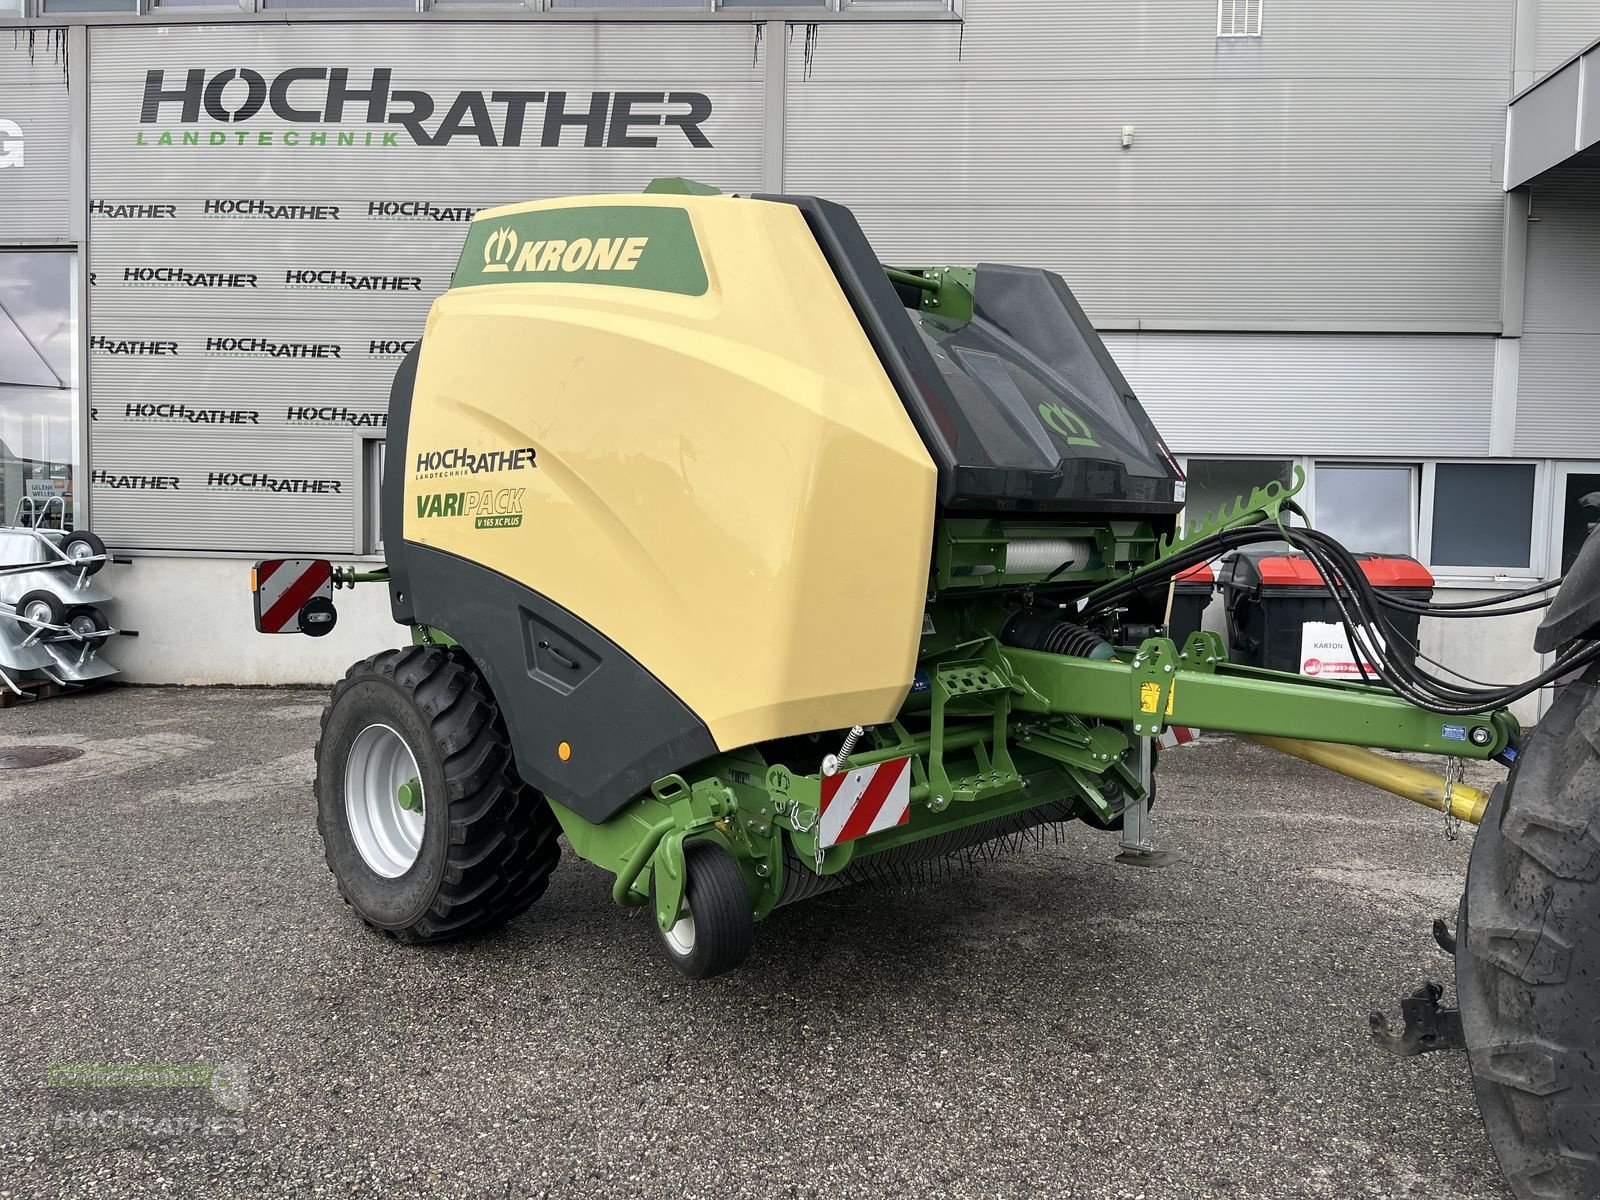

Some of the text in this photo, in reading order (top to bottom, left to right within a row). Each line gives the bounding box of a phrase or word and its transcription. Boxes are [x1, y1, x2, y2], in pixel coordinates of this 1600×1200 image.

[139, 67, 713, 148] HOCHRATHER
[136, 131, 399, 147] LANDTECHNIK
[204, 199, 341, 220] HOCHRATHER
[513, 236, 649, 273] KRONE
[123, 267, 259, 288] HOCHRATHER
[285, 270, 422, 291] HOCHRATHER
[206, 337, 342, 359] HOCHRATHER
[125, 403, 260, 425] HOCHRATHER
[416, 447, 538, 474] HOCHRATHER
[207, 472, 342, 494] HOCHRATHER
[415, 469, 469, 481] LANDTECHNIK
[477, 516, 520, 527] V 165 XC PLUS
